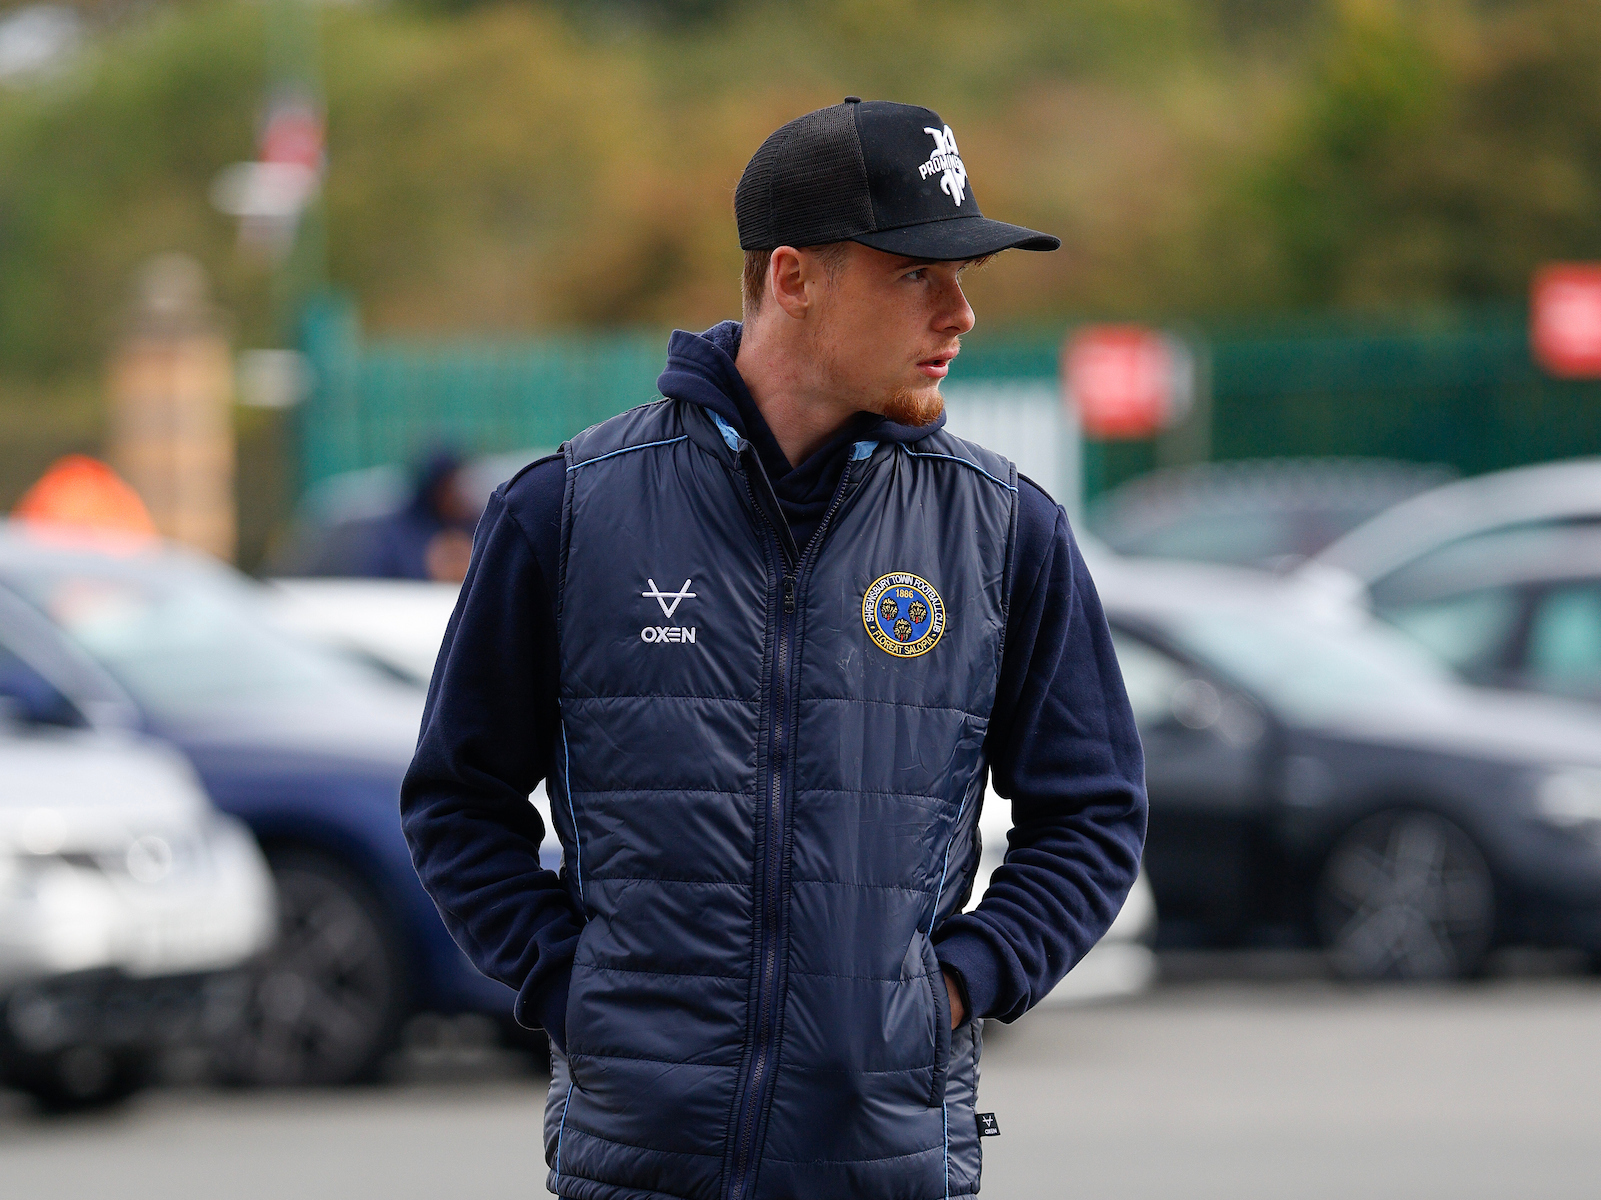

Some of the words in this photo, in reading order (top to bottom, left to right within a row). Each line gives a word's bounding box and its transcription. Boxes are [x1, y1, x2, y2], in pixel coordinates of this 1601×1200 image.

[864, 577, 891, 622] SHREWSBURY
[890, 574, 914, 585] TOWN
[914, 578, 942, 612] FOOTBALL
[932, 612, 943, 633] CLUB
[895, 588, 914, 599] 1886
[641, 626, 696, 643] OXEN
[872, 630, 903, 654] FLOREAT
[904, 636, 935, 655] SALOPIA
